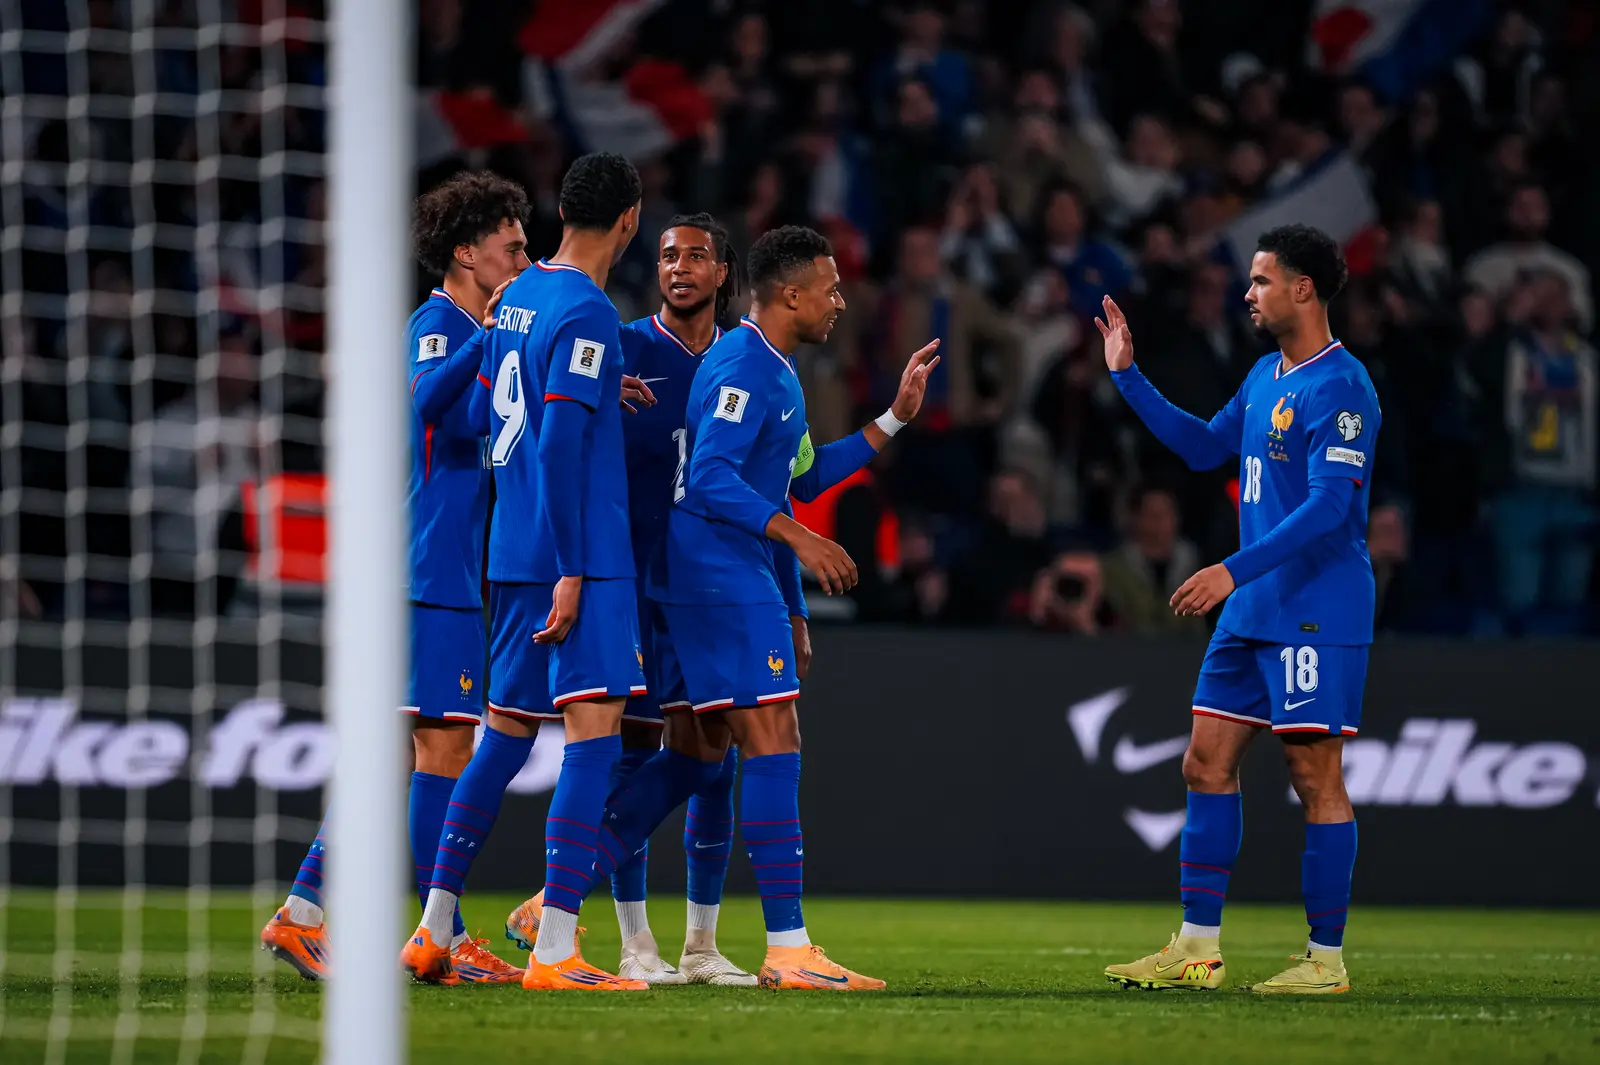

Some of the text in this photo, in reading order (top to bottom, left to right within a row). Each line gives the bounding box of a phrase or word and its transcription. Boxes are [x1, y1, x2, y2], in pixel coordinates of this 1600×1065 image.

[492, 350, 527, 466] 9
[1243, 455, 1262, 505] 18
[1280, 645, 1319, 694] 18
